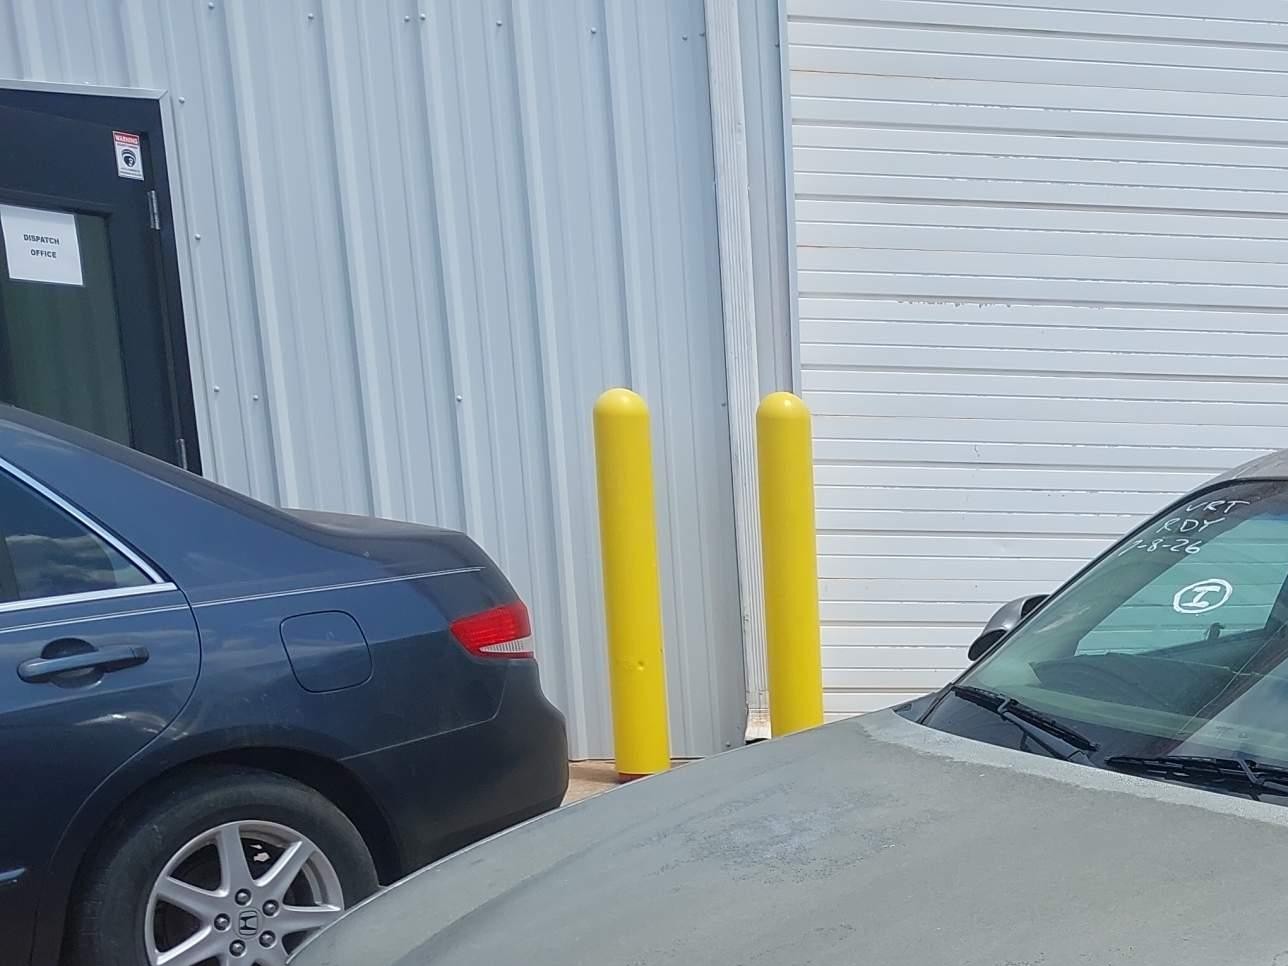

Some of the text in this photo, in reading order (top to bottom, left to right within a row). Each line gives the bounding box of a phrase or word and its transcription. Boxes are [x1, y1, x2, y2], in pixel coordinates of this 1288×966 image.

[23, 234, 60, 245] DISPATCH
[30, 249, 57, 258] OFFICE
[1156, 517, 1226, 533] RDY
